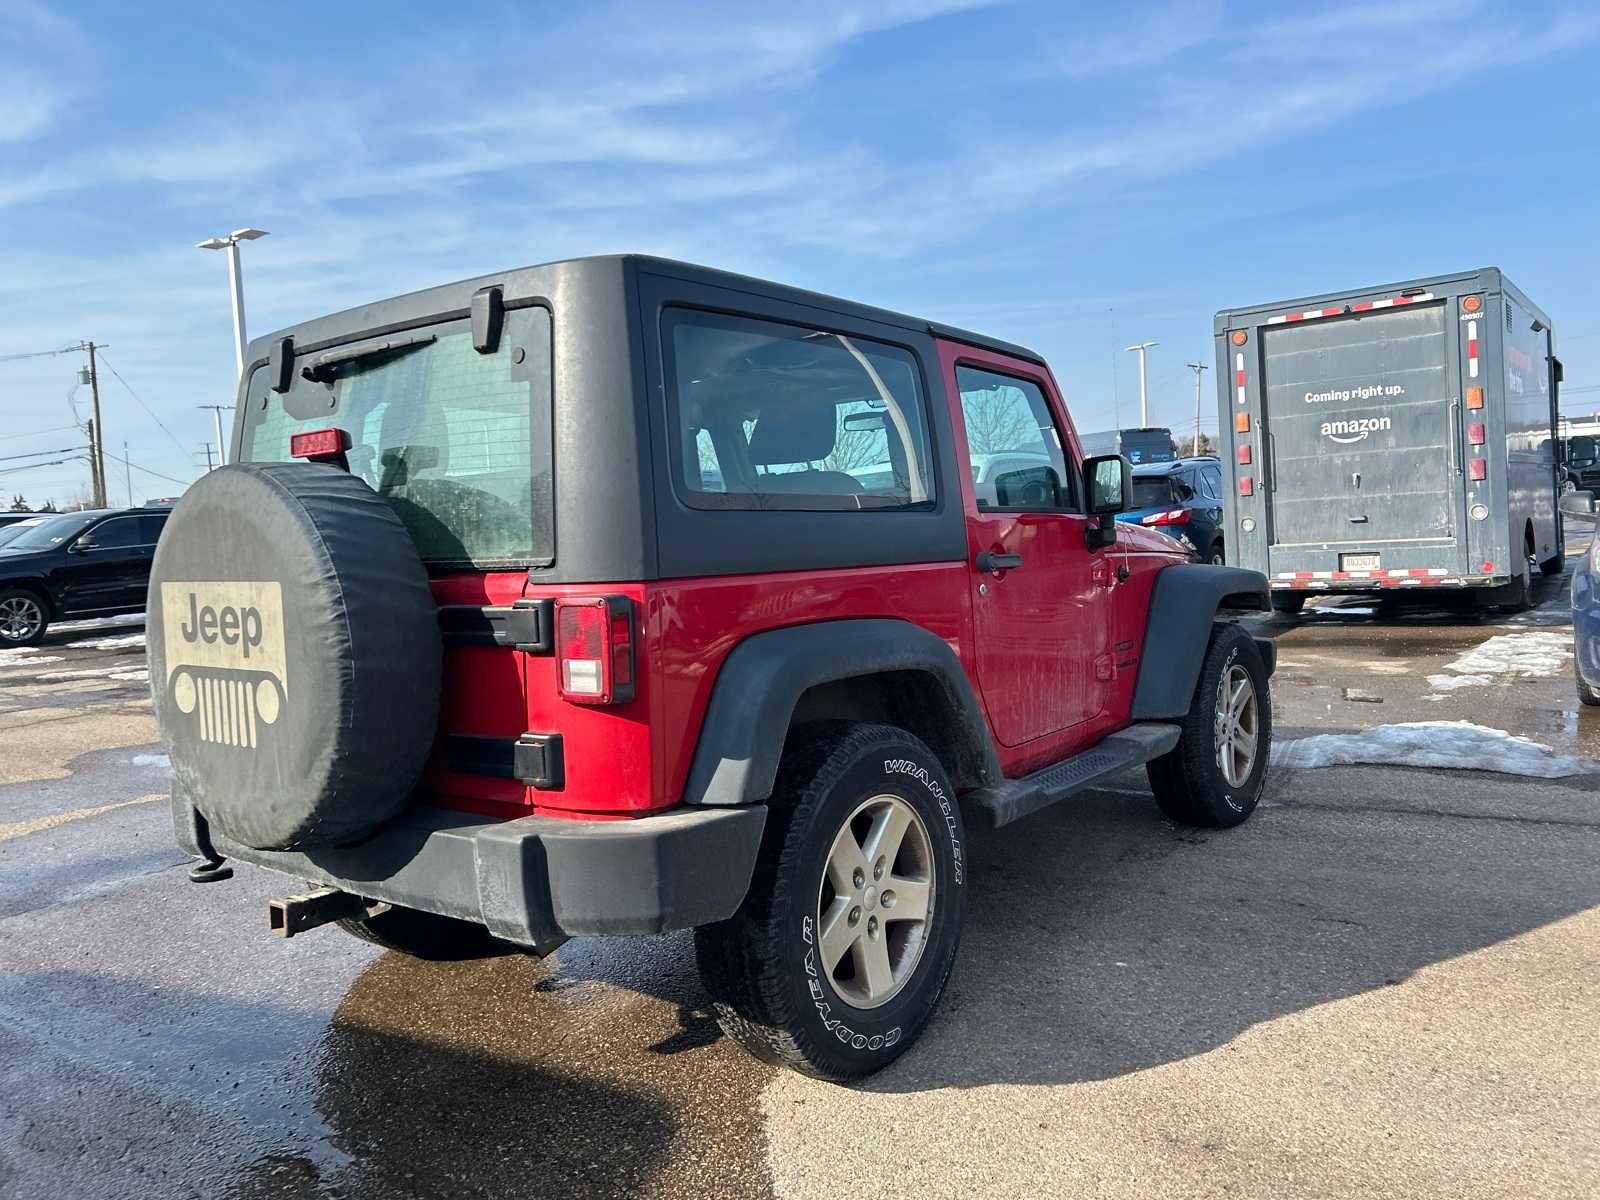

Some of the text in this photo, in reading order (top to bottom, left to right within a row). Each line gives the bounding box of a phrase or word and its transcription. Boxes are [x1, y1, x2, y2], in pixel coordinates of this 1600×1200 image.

[1304, 384, 1405, 402] Coming right up.
[1320, 416, 1391, 435] amazon
[181, 593, 263, 658] Jeep
[884, 759, 963, 885] WRANGLER
[802, 915, 902, 1051] GOODYEAR
